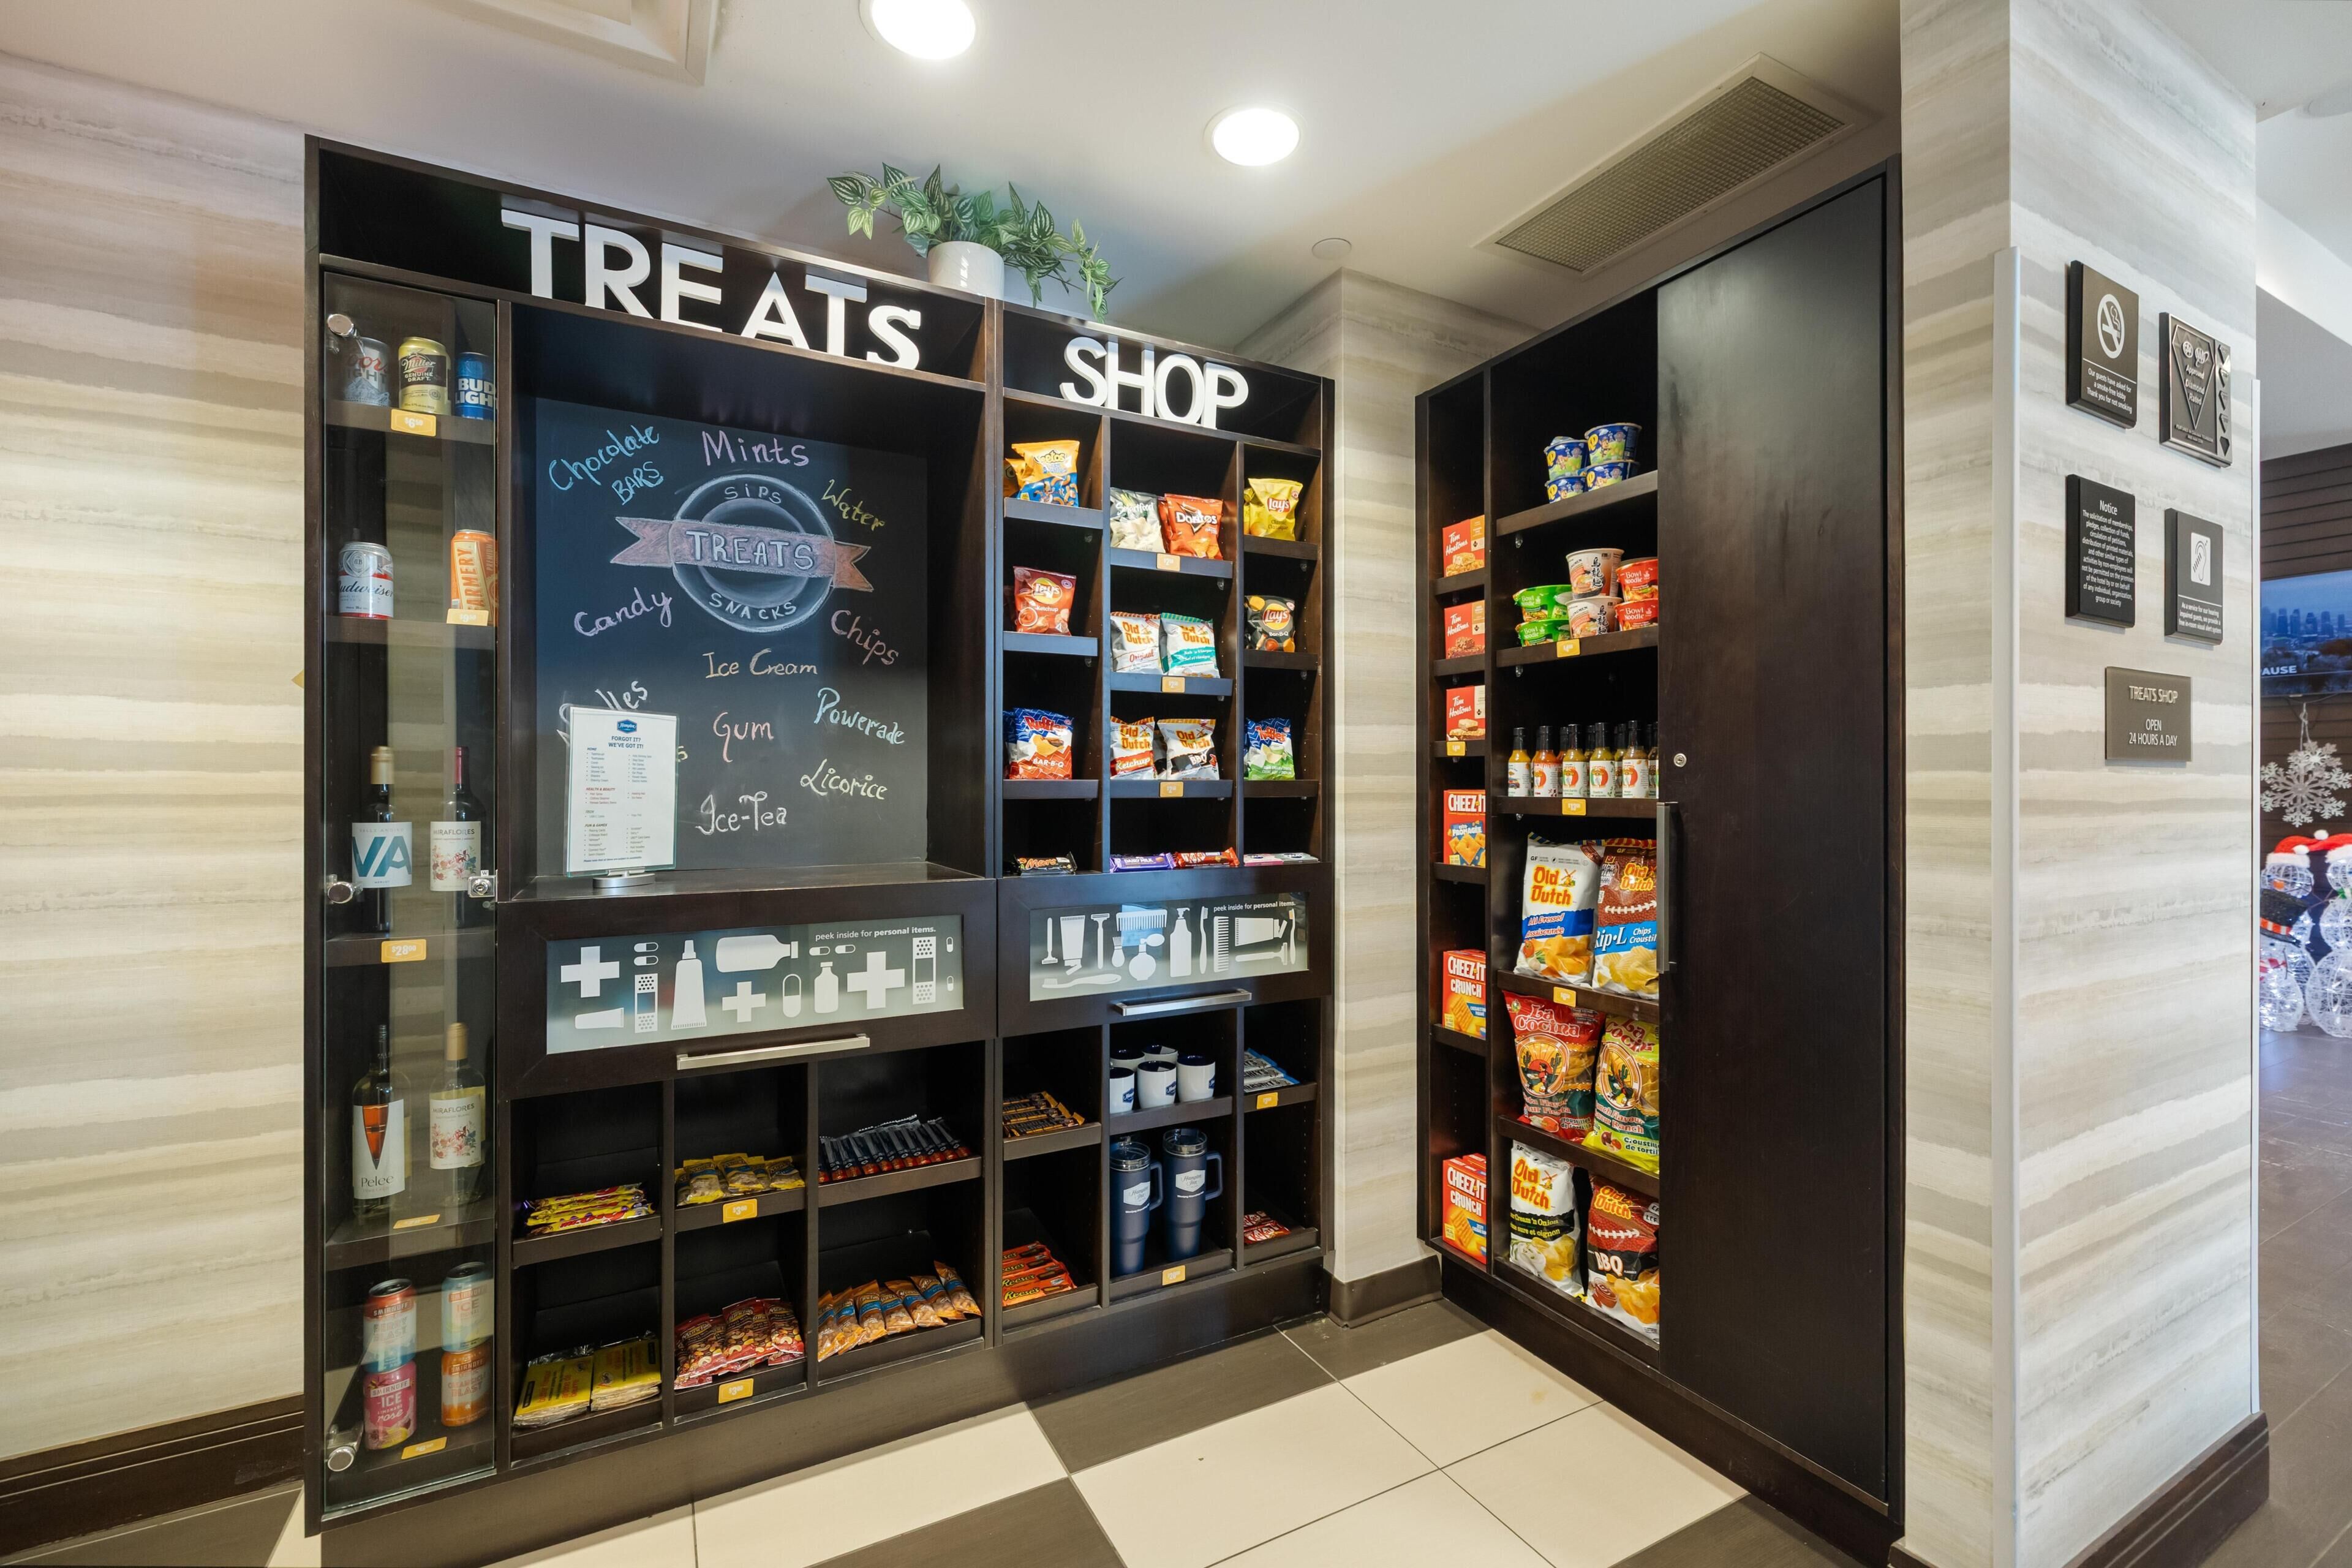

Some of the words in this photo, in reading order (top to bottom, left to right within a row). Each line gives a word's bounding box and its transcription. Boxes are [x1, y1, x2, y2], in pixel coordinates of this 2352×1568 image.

[501, 209, 921, 370] TREATS
[1060, 337, 1249, 429] SHOP
[401, 355, 436, 373] Miller
[2186, 365, 2204, 379] Approved
[458, 378, 496, 394] BUD
[2095, 372, 2107, 382] guests
[2107, 376, 2116, 386] have
[2116, 382, 2126, 391] asked
[2185, 379, 2205, 395] Diamond
[2087, 386, 2098, 398] Thank
[2118, 402, 2132, 414] smoking
[2097, 383, 2116, 396] smoke-free
[2116, 390, 2126, 402] lobby
[2189, 393, 2202, 405] Rated
[702, 430, 809, 467] Mints
[549, 425, 659, 490] Chocolate
[612, 461, 663, 505] BARS
[821, 480, 884, 530] Water
[1115, 499, 1156, 516] Smartfood
[1267, 497, 1290, 512] Lay's
[2100, 500, 2117, 515] Notice
[1175, 511, 1218, 524] Doritos
[2089, 513, 2107, 523] solicitation
[1448, 531, 1461, 544] Tim
[2086, 521, 2100, 530] pledges,
[2100, 525, 2116, 535] collection
[2120, 529, 2130, 540] funds,
[2090, 530, 2107, 540] circulation
[685, 530, 814, 570] TREATS
[1446, 539, 1468, 556] Hortons
[2082, 537, 2101, 548] distribution
[1626, 570, 1642, 579] Bowl
[2093, 568, 2109, 577] permitted
[2097, 576, 2106, 585] hotel
[2119, 581, 2130, 590] behalf
[2095, 595, 2106, 604] group
[2110, 598, 2121, 608] society
[2111, 590, 2133, 601] organization,
[574, 587, 672, 636] Candy
[709, 592, 797, 620] SNACKS
[1265, 611, 1289, 623] Lay's
[1450, 613, 1462, 625] Tim
[1122, 620, 1140, 634] Old
[1447, 622, 1469, 637] Hortons
[831, 610, 899, 665] Chips
[1125, 632, 1155, 644] Dutch
[1182, 632, 1211, 644] Dutch
[1129, 649, 1155, 663] Original
[702, 652, 739, 679] Ice
[749, 649, 818, 676] Cream
[1452, 695, 1464, 707] Tim
[2128, 685, 2157, 702] TREATS
[2158, 688, 2178, 704] SHOP
[813, 687, 905, 744] Powerade
[1449, 705, 1471, 718] Hortons
[1023, 715, 1068, 731] Ruffles
[2146, 718, 2162, 731] OPEN
[713, 712, 774, 763] Gum
[1120, 725, 1139, 737] Old
[1176, 730, 1195, 741] Old
[1255, 725, 1286, 742] Ruffles
[1121, 737, 1151, 749] Dutch
[2129, 733, 2136, 744] 24
[2138, 733, 2158, 745] HOURS
[2159, 734, 2164, 745] A
[2165, 734, 2177, 746] DAY
[1033, 758, 1064, 768] BAR-B-Q
[1116, 758, 1151, 769] Ketchup
[801, 758, 888, 800] Licorice
[695, 791, 787, 835] Ice-Tea
[352, 836, 412, 877] VA
[1025, 858, 1057, 869] Mars
[1533, 865, 1559, 885] Old
[1624, 863, 1648, 878] Old
[1620, 876, 1654, 891] Dutch
[1531, 885, 1572, 906] Dutch
[1253, 900, 1278, 910] personal
[1528, 916, 1539, 926] All
[1539, 913, 1565, 924] Dressed
[815, 932, 834, 941] peek
[874, 927, 910, 938] personal
[1450, 978, 1482, 998] CRUNCH
[1530, 1005, 1555, 1020] La
[1514, 1014, 1580, 1037] Cocina
[1623, 1019, 1646, 1038] La
[432, 1103, 475, 1114] MIRAFLORES
[1612, 1120, 1644, 1134] Ranch
[1513, 1158, 1539, 1182] Old
[1512, 1177, 1550, 1211] Dutch
[1600, 1186, 1626, 1200] Old
[1450, 1190, 1482, 1217] CRUNCH
[1594, 1196, 1631, 1219] Dutch
[1515, 1214, 1530, 1223] Cream
[1537, 1218, 1559, 1226] Onion
[1537, 1228, 1560, 1238] oignon
[1594, 1251, 1623, 1276] BBQ
[373, 1302, 409, 1316] SMIRNOFF
[451, 1359, 484, 1373] SMIRNOFF
[372, 1381, 409, 1396] SMIRNOFF
[381, 1393, 402, 1408] ICE
